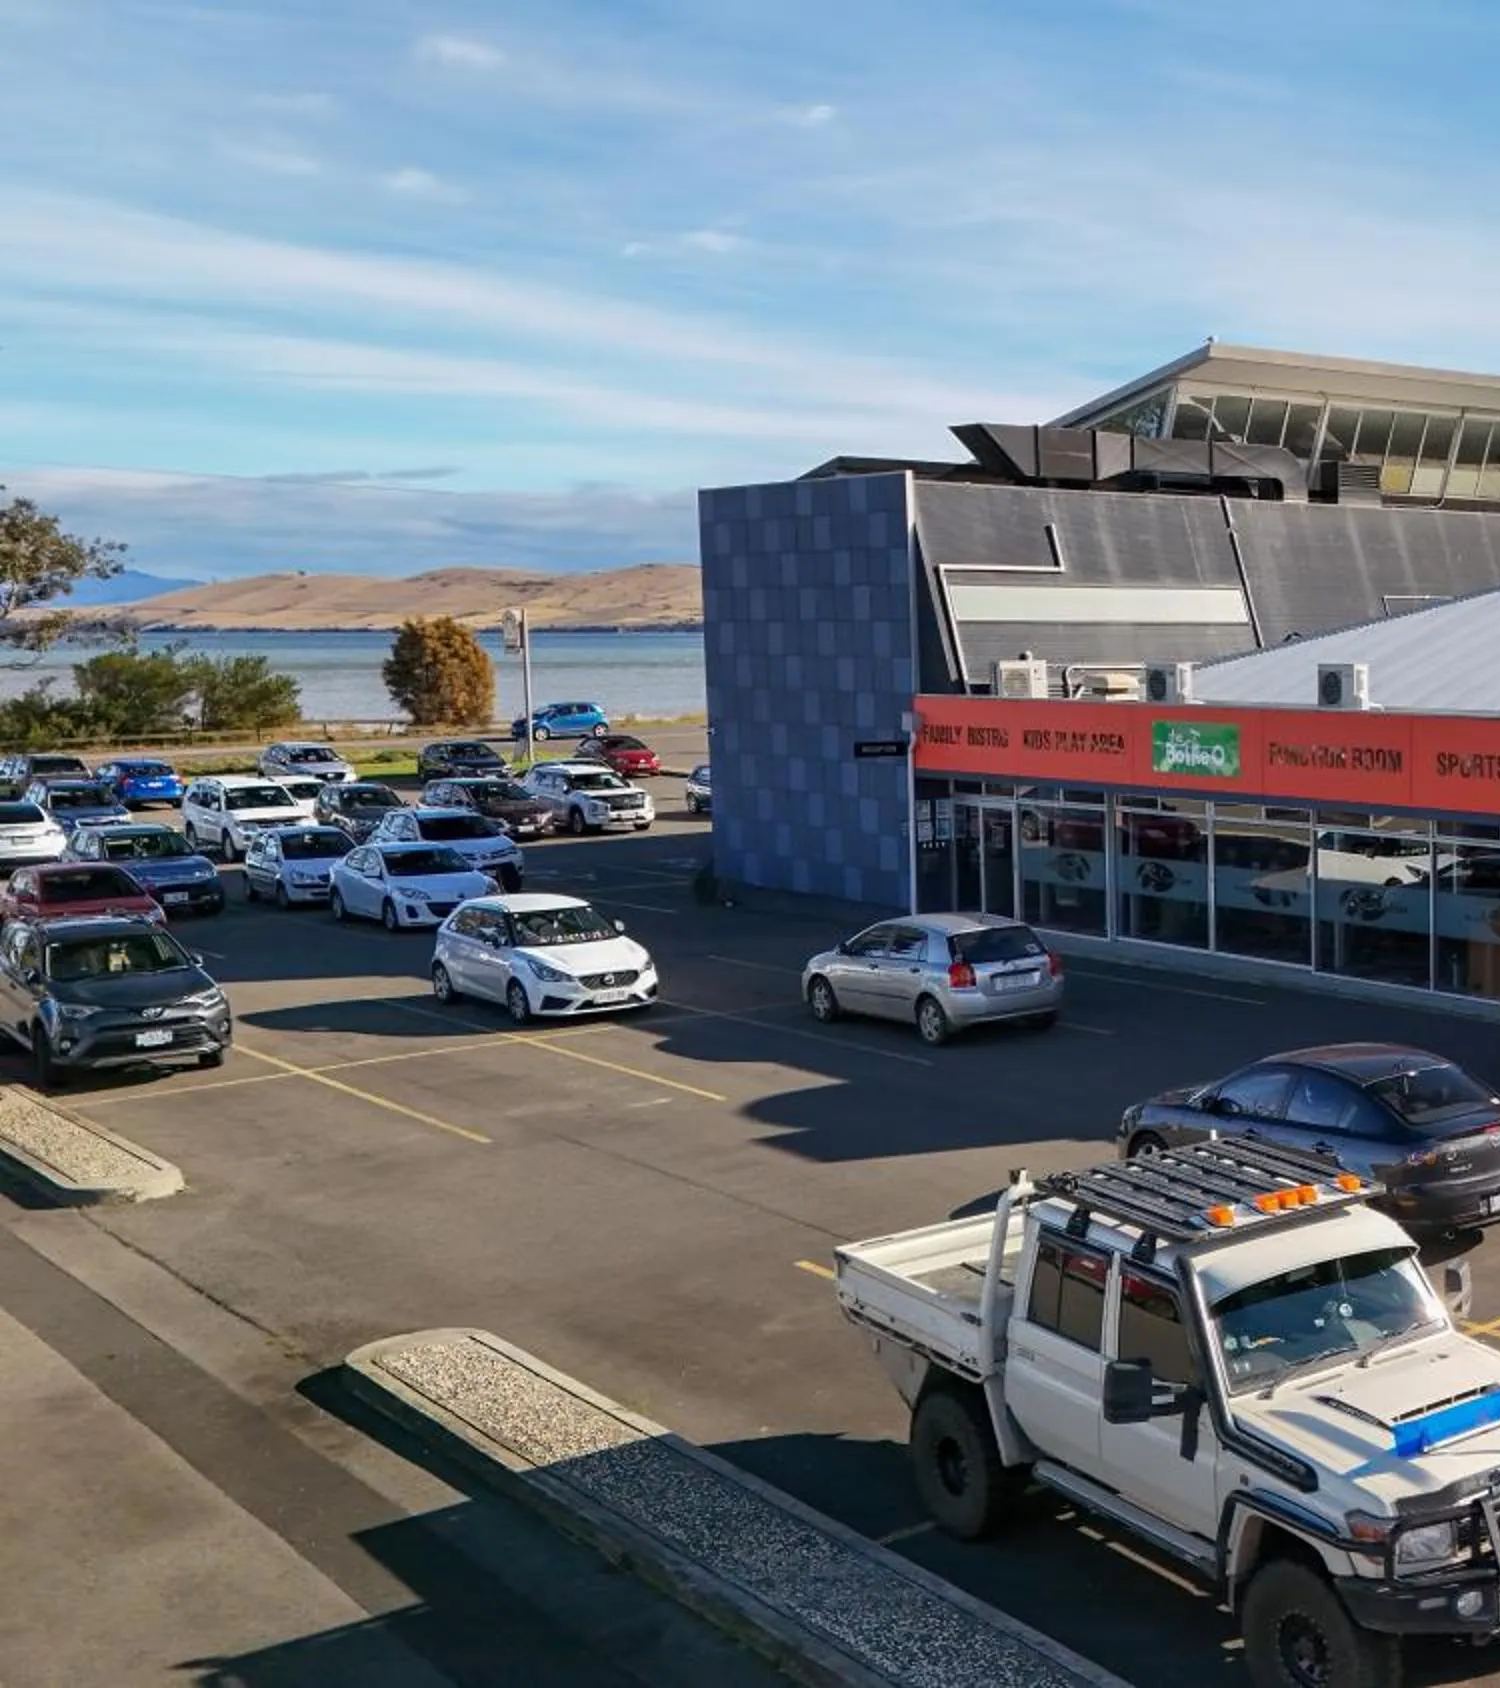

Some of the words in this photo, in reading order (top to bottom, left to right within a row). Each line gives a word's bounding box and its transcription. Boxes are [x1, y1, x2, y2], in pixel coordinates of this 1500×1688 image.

[923, 723, 962, 745] FAMILY
[967, 726, 1009, 749] BISTRO
[1023, 730, 1051, 751] KIDS
[1054, 731, 1087, 753] PLAY
[1090, 733, 1125, 755] AREA
[1351, 747, 1403, 773] ROOM
